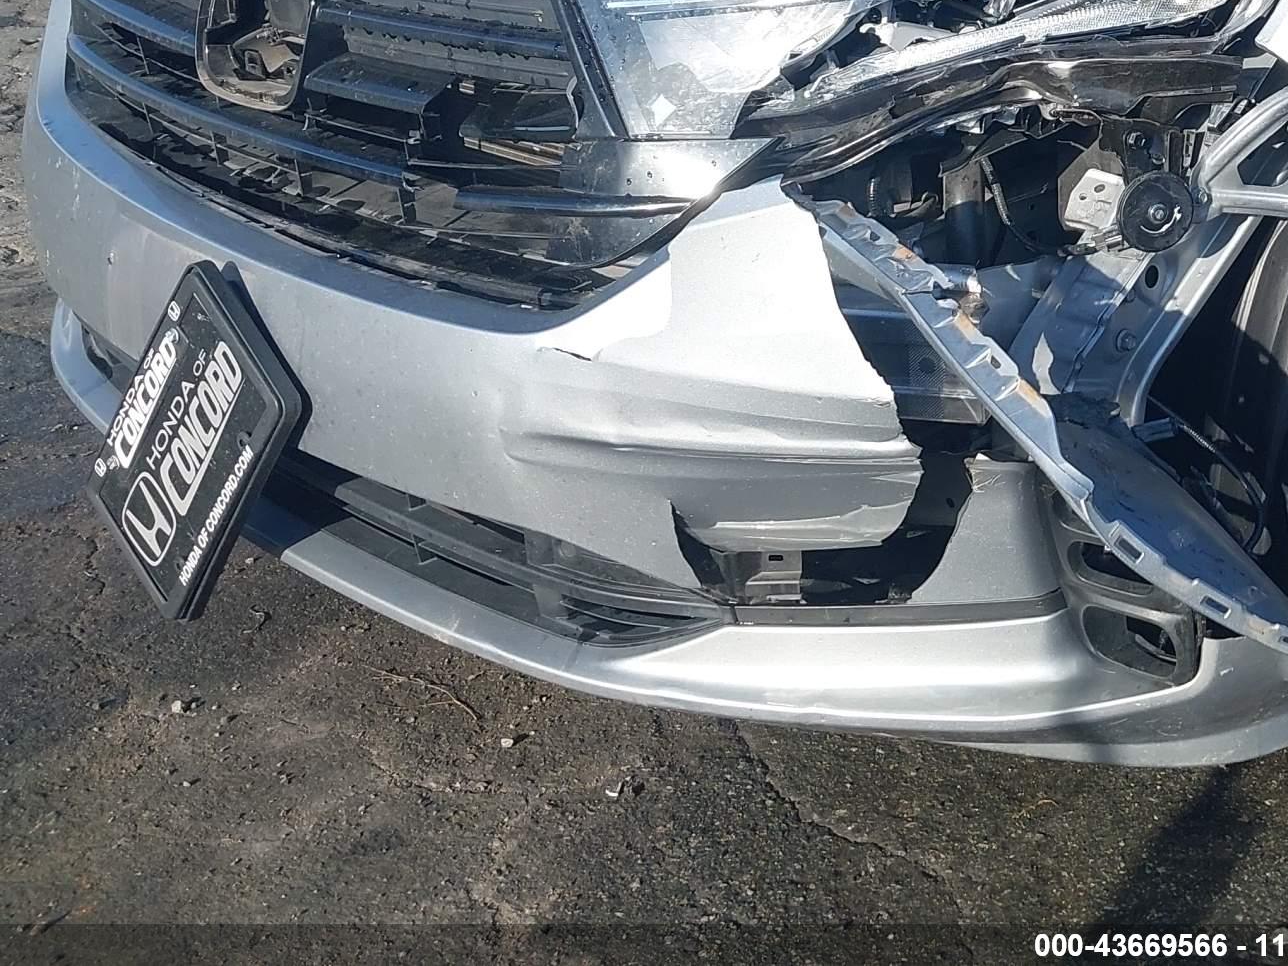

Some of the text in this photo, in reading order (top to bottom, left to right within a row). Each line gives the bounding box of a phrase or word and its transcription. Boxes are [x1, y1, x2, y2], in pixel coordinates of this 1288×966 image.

[107, 374, 144, 446] HONDA
[115, 335, 177, 468] CONCORD
[146, 348, 207, 469] HONDA OF
[160, 340, 243, 515] CONCORD
[178, 444, 253, 586] HONDA OF CONCORD.COM
